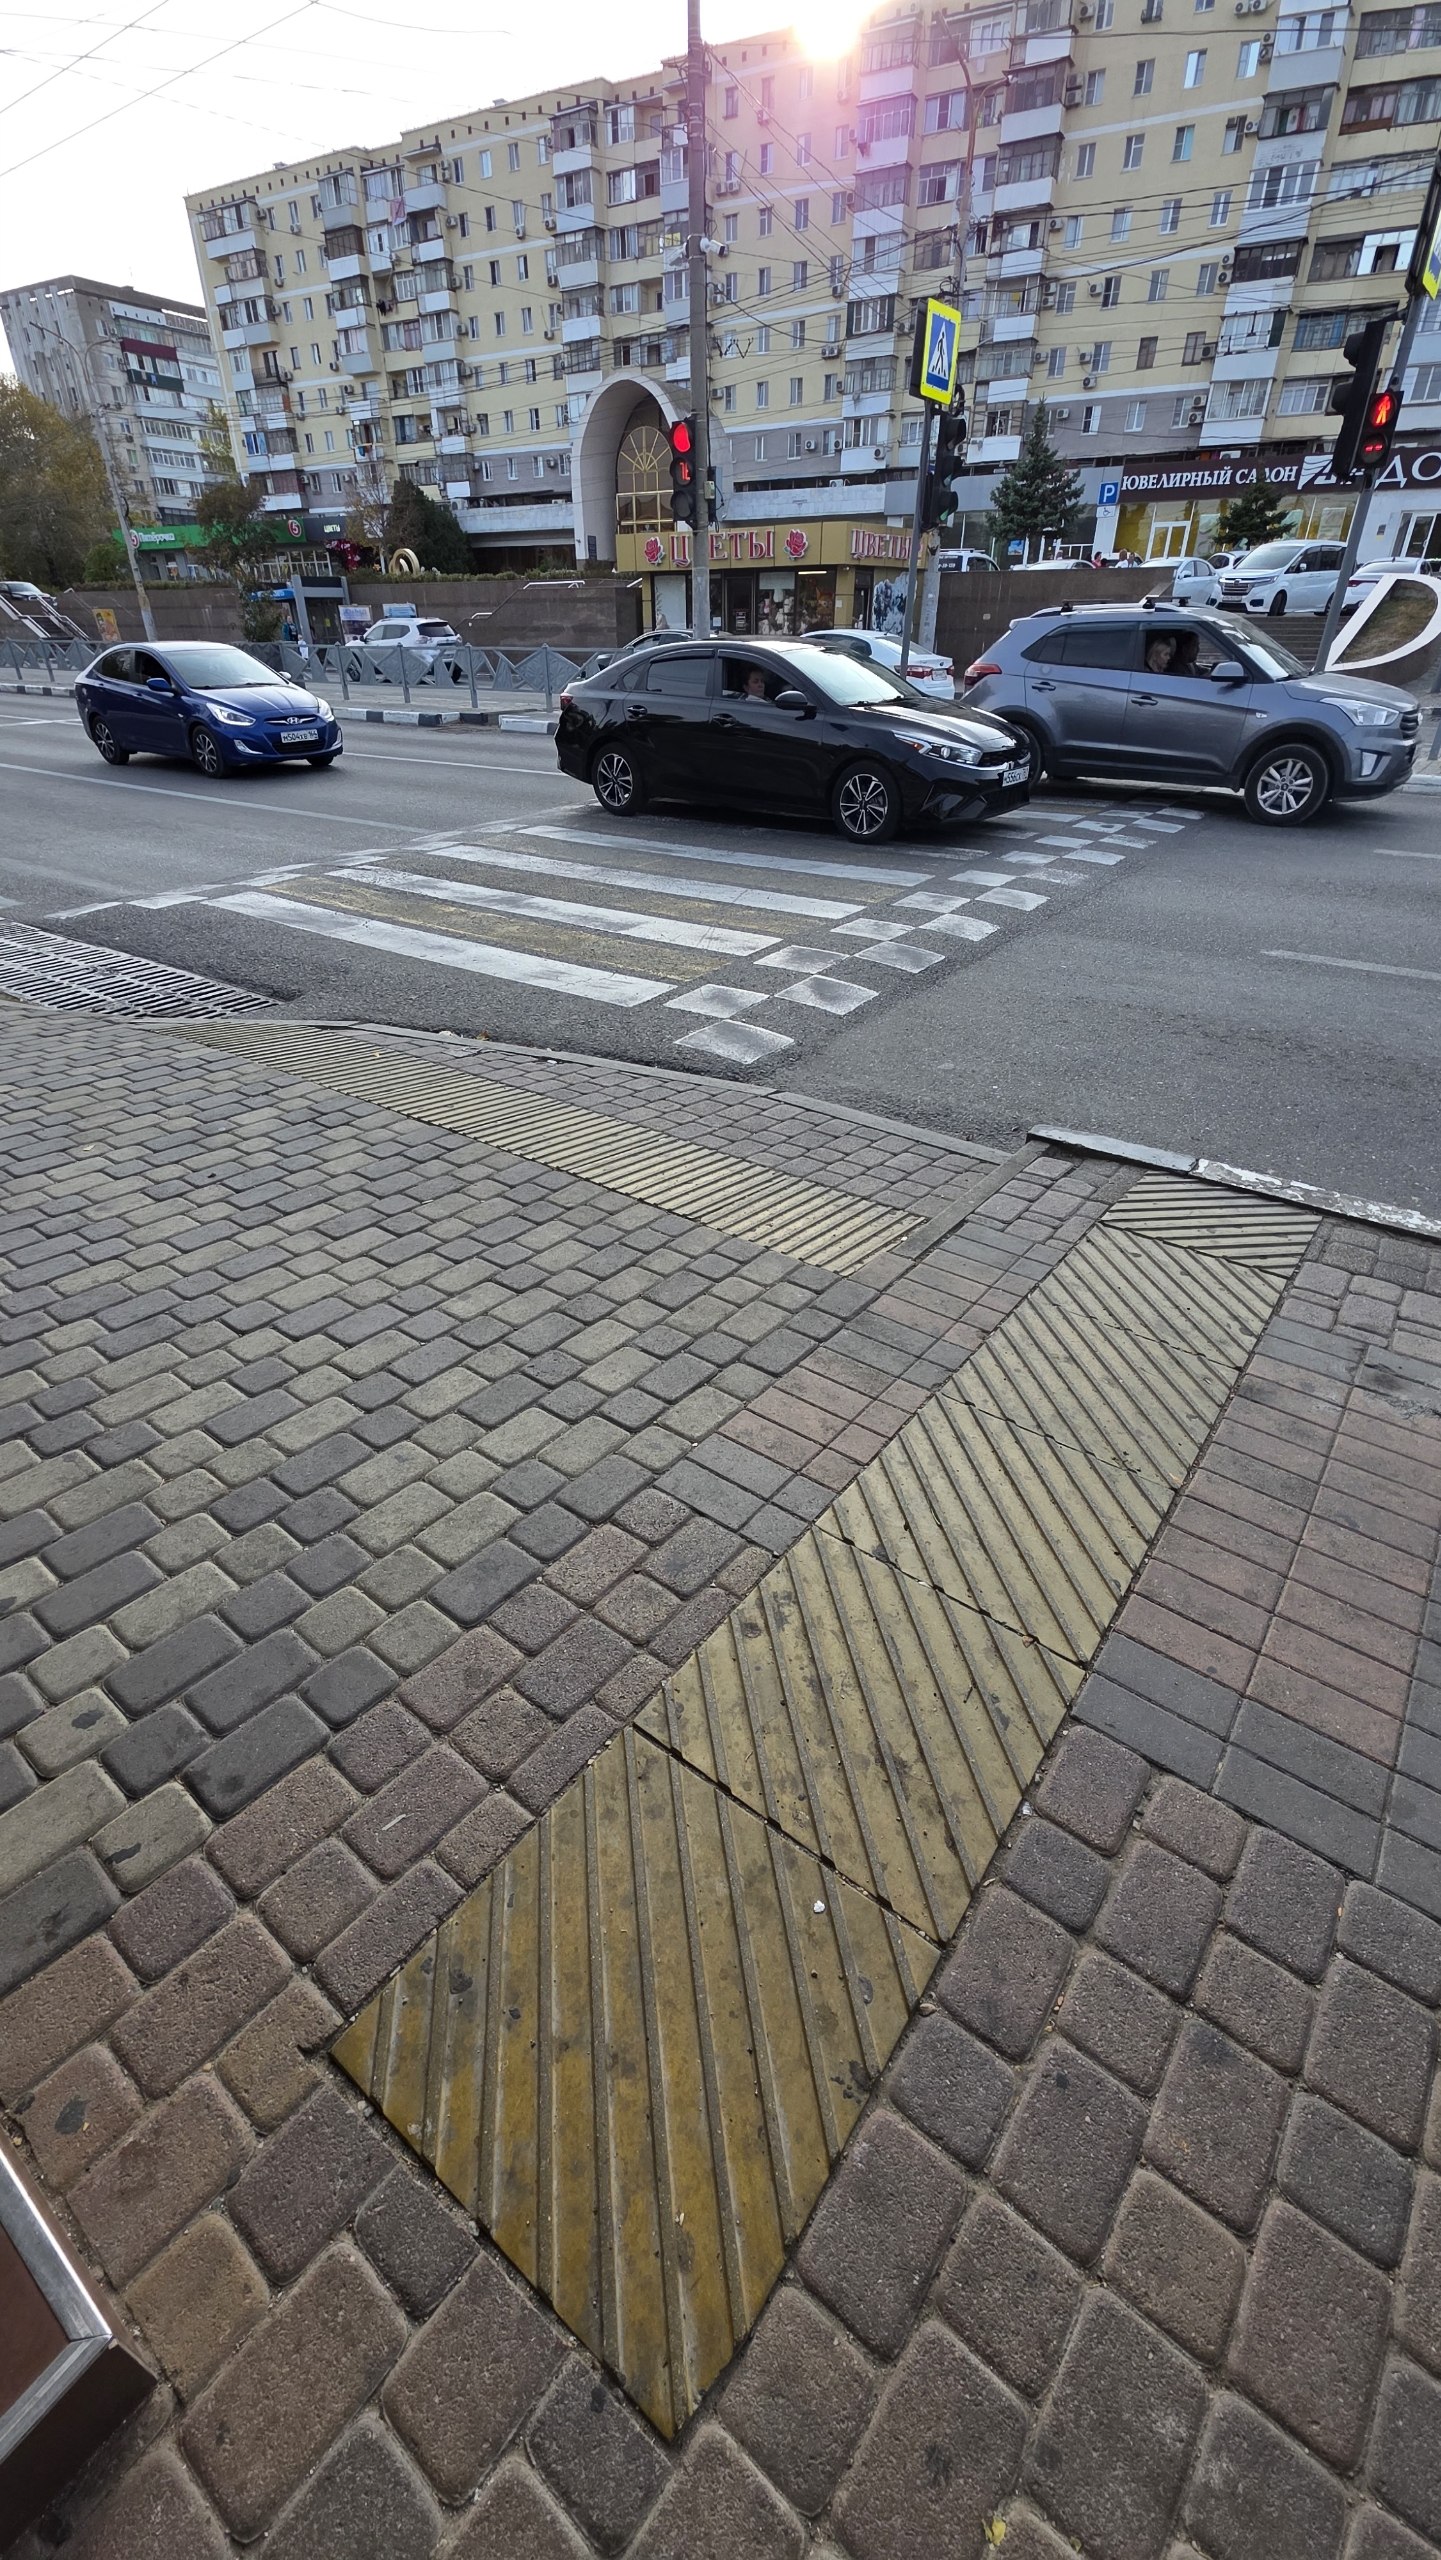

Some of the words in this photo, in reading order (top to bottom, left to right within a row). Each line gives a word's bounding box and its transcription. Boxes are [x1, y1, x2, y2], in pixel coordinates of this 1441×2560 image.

[1121, 466, 1234, 491] ЮВЕЛИРНЫЙ
[670, 529, 774, 567] ЦЕТЫ
[851, 528, 912, 560] ЦВЕТЫ
